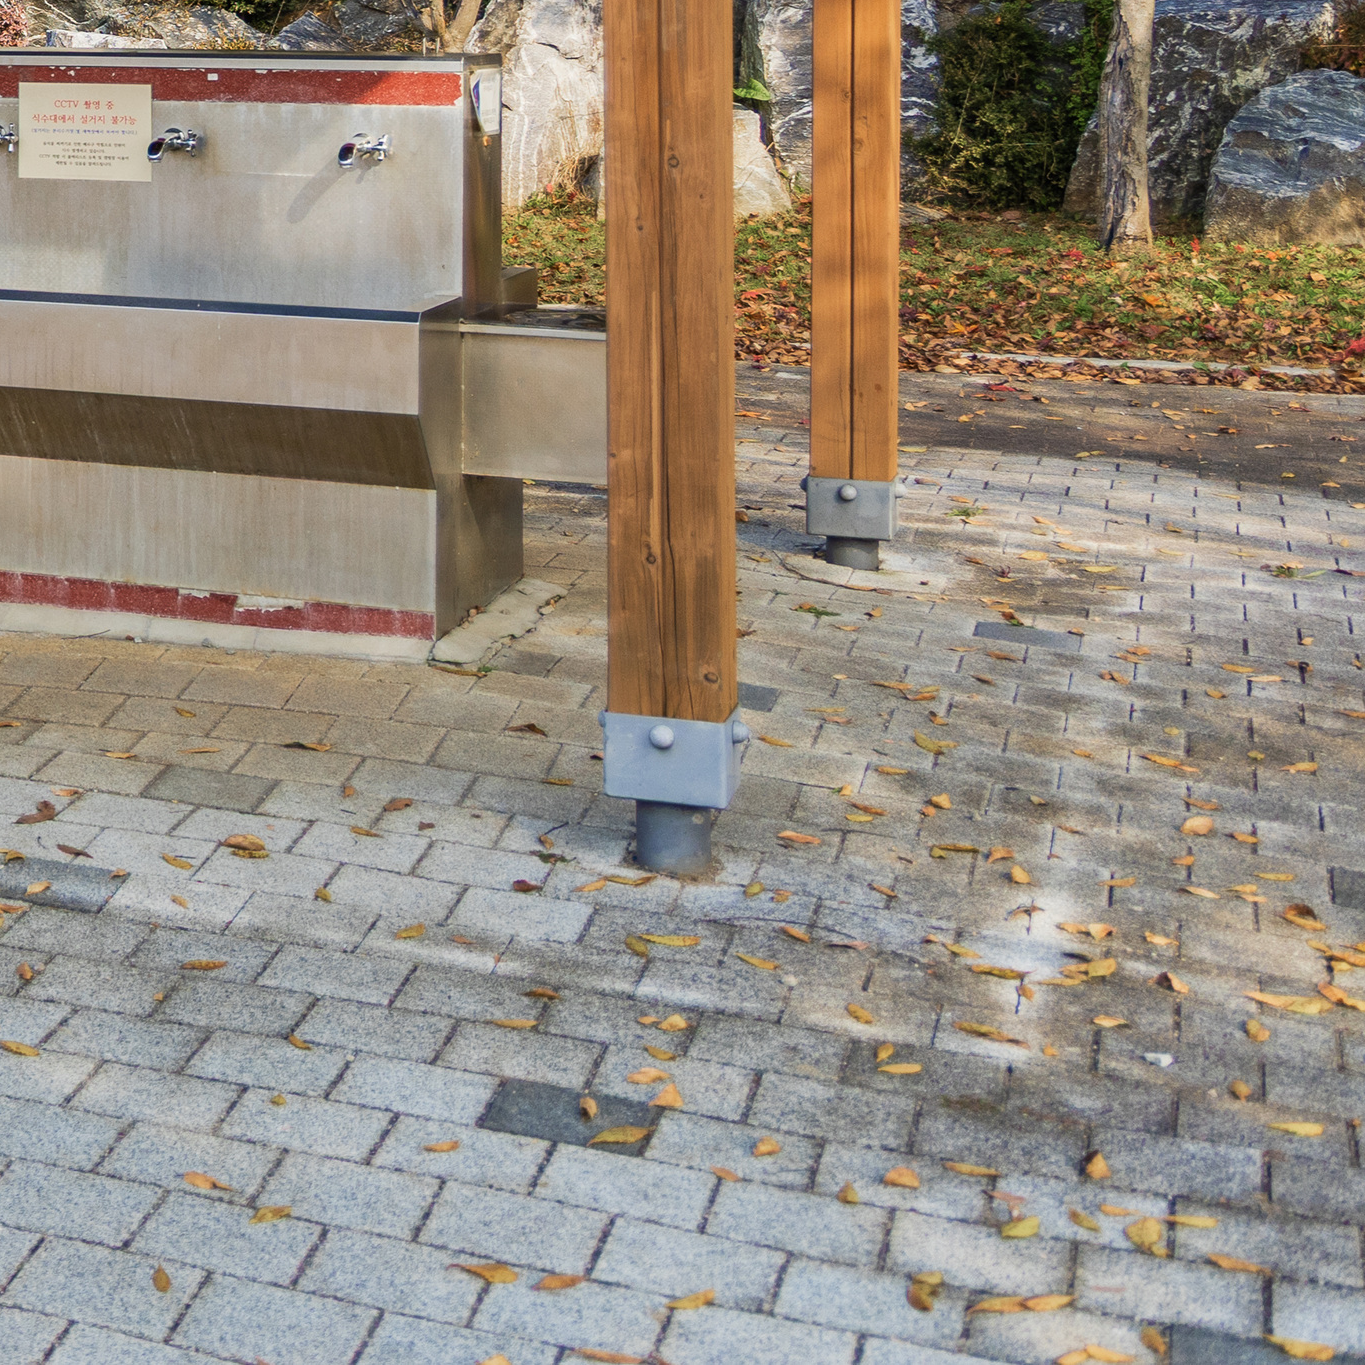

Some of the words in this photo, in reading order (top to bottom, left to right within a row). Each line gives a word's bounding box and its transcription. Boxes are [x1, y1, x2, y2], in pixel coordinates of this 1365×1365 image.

[53, 99, 79, 109] CCTV
[83, 100, 101, 110] 촬영
[105, 100, 115, 110] 중
[31, 113, 76, 123] 식수대에서
[79, 114, 107, 124] 설거지
[110, 115, 138, 125] 불가능
